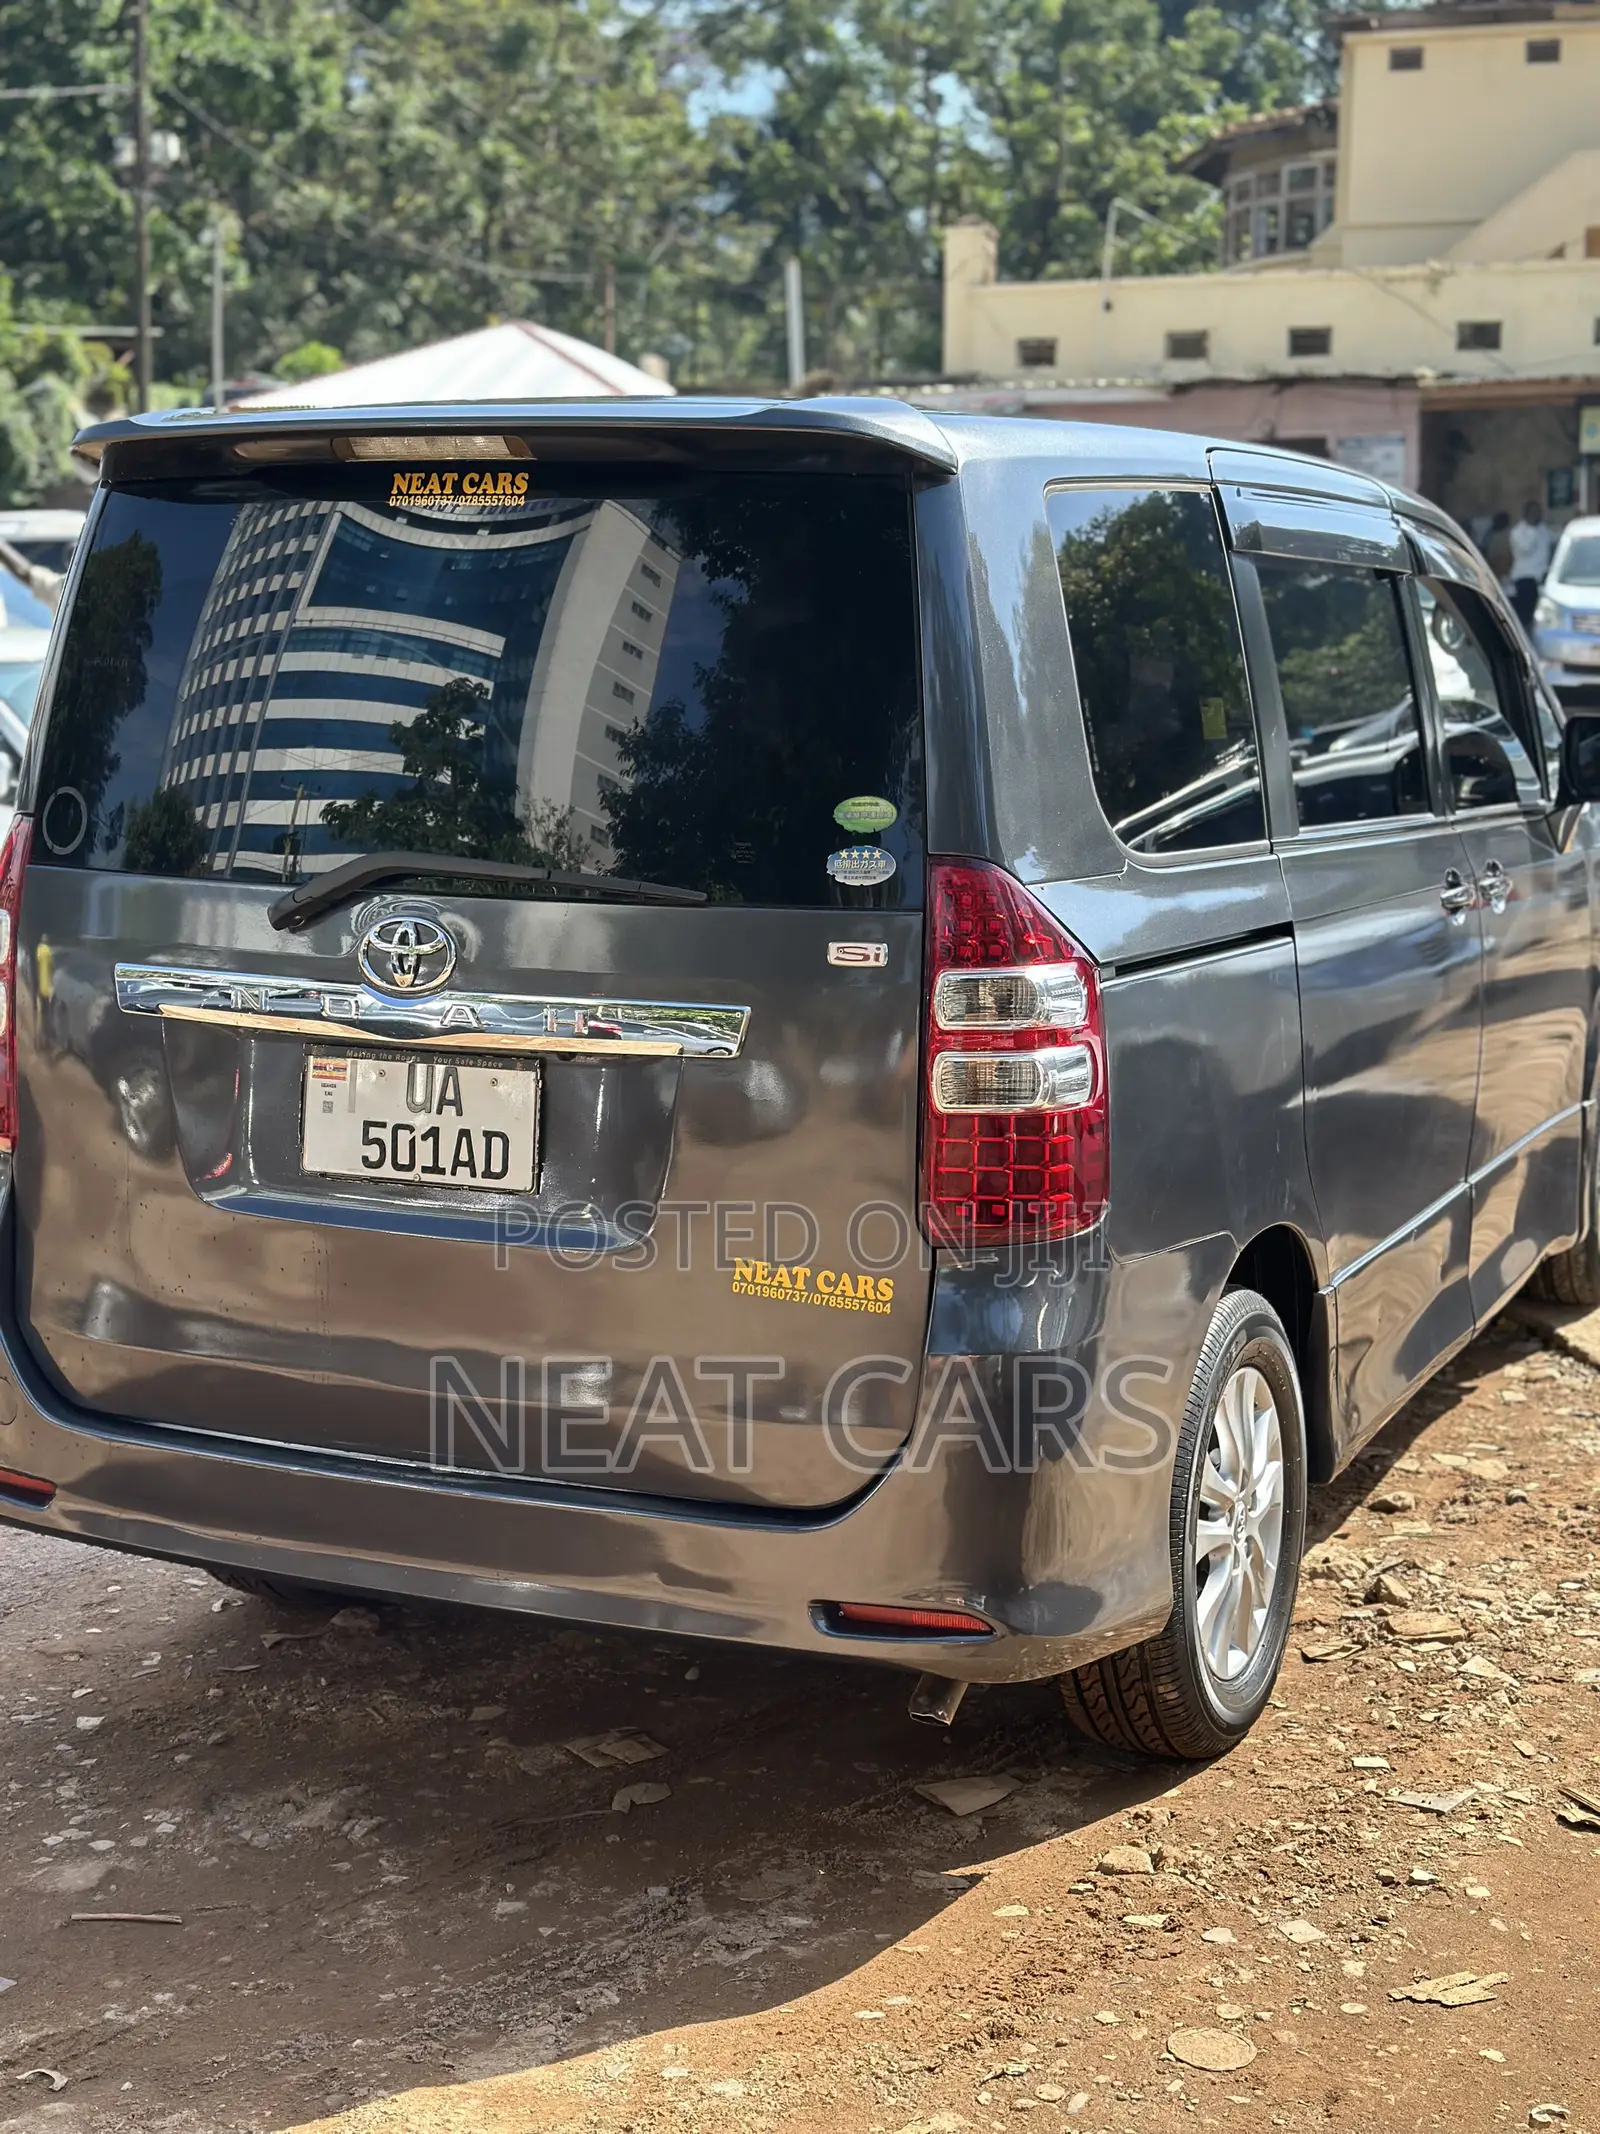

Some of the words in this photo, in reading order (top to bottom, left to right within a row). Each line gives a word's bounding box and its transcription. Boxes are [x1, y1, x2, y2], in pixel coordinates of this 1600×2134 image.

[389, 495, 525, 507] 0701960737/0785557604
[391, 472, 458, 495] NEAT
[462, 472, 529, 495] CARS
[231, 985, 588, 1035] NOAH
[406, 1063, 463, 1117] UA
[361, 1120, 510, 1180] 501AD
[732, 1282, 891, 1314] 0701960737/0785557604
[734, 1258, 810, 1290] NEAT
[817, 1271, 894, 1302] CARS
